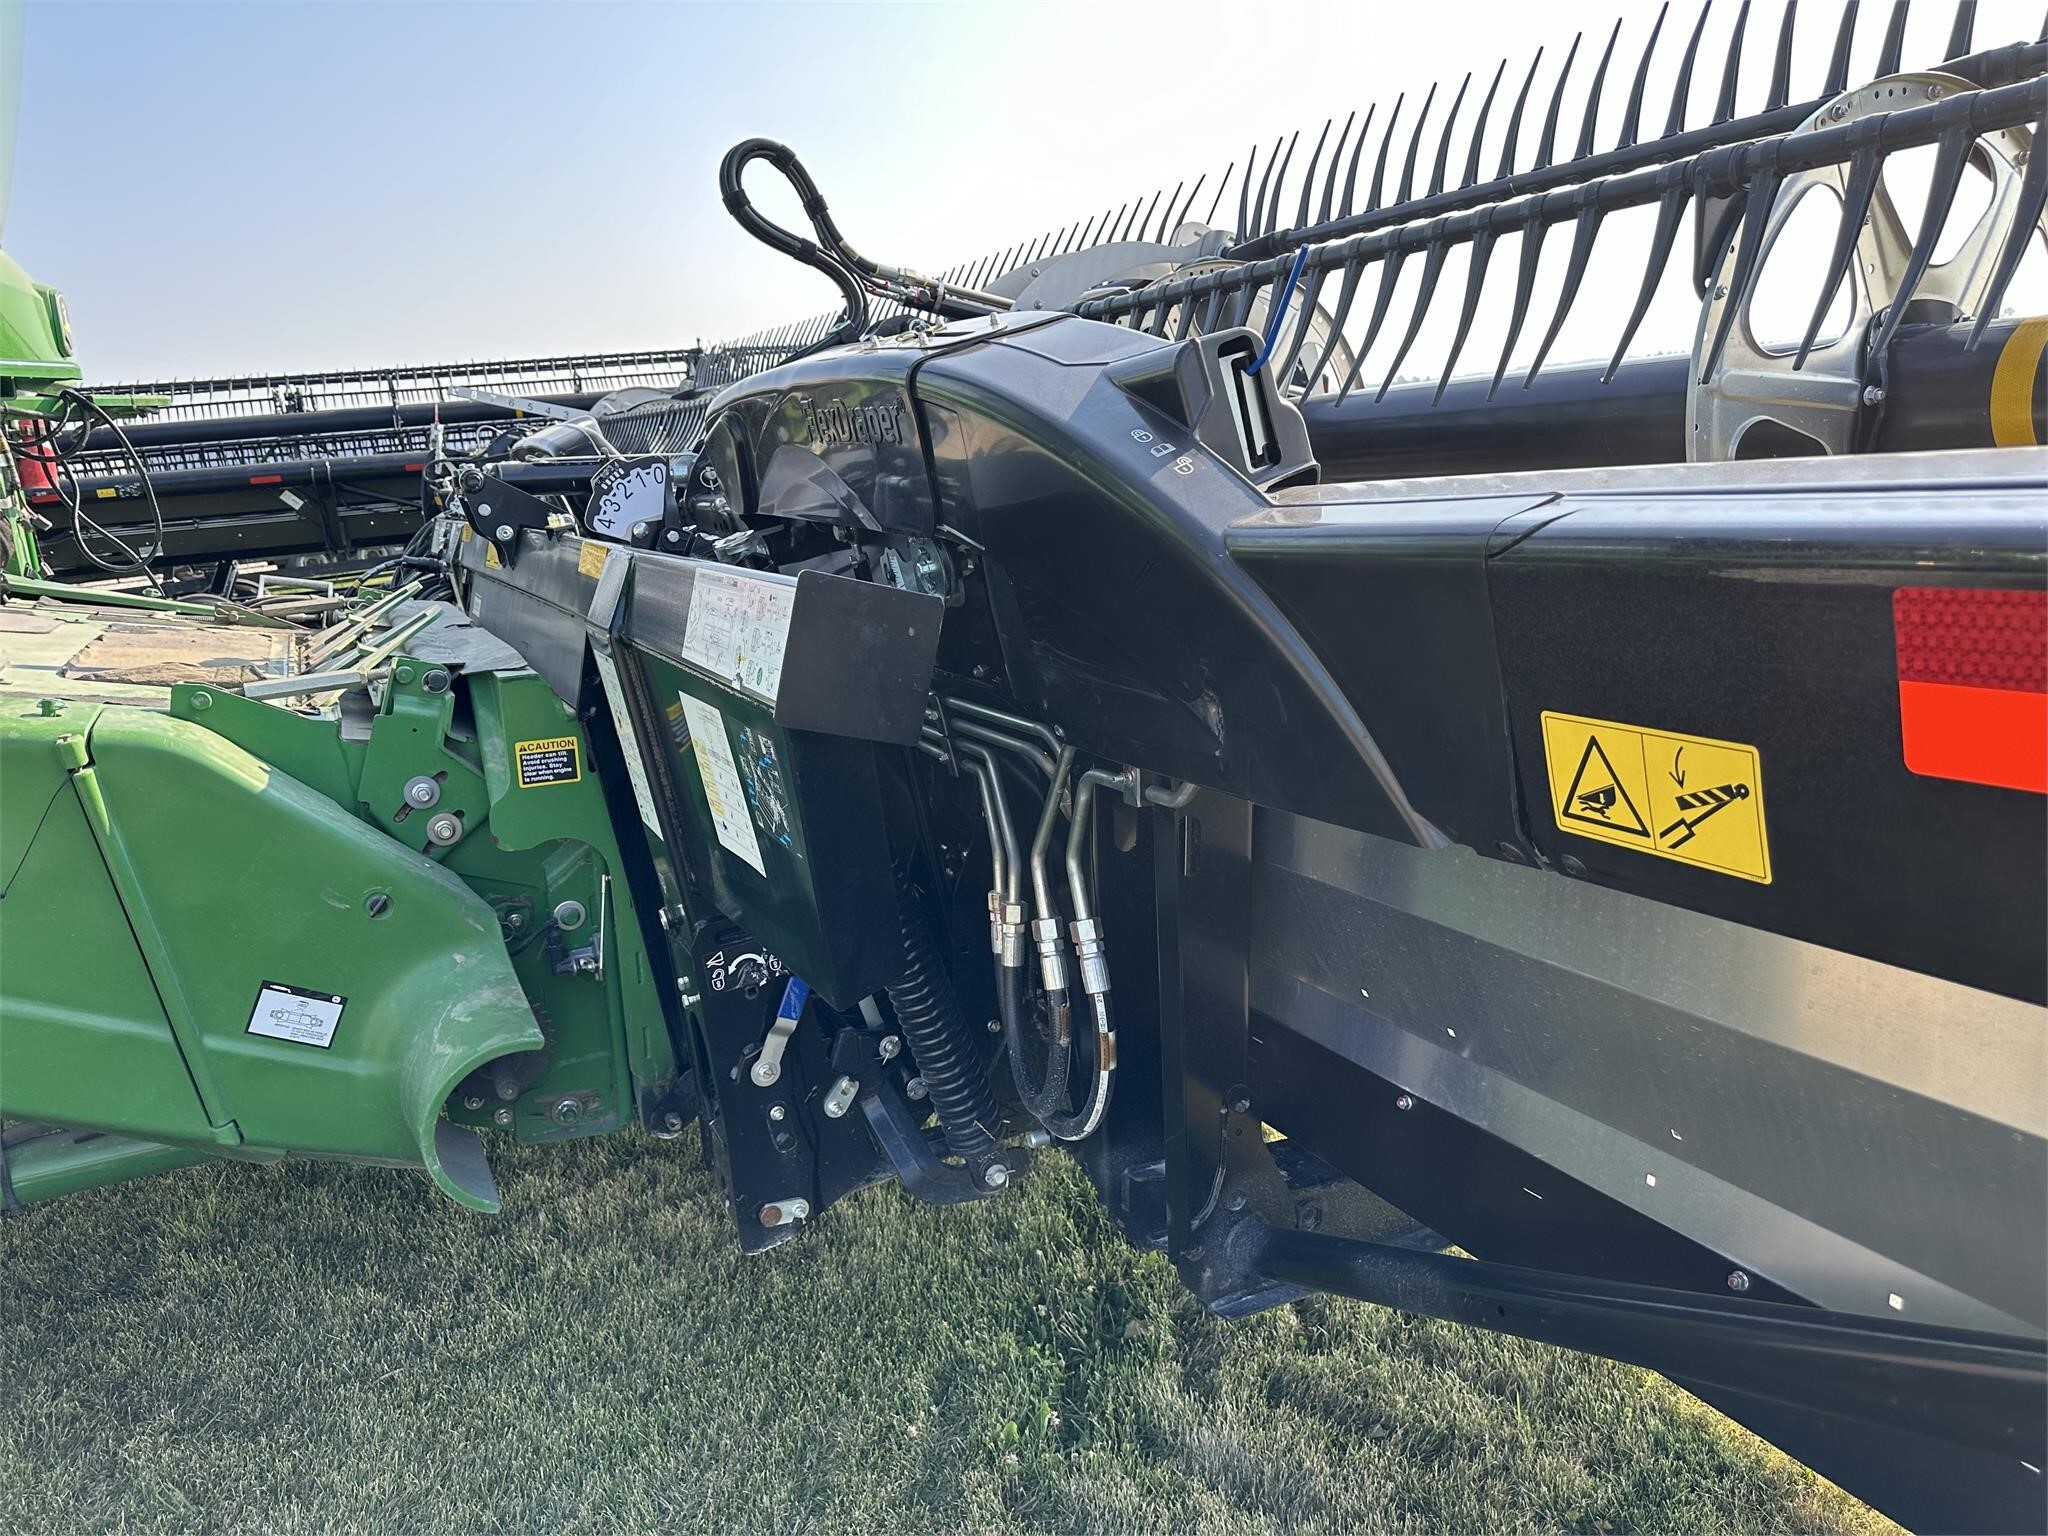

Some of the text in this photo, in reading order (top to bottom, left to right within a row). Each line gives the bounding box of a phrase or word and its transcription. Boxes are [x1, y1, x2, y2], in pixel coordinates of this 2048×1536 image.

[528, 402, 534, 411] 5
[800, 398, 903, 453] FlexDraper
[636, 472, 646, 488] 1
[654, 466, 664, 484] 0
[616, 482, 634, 500] 2
[604, 499, 621, 512] 3
[597, 518, 616, 529] 4
[528, 739, 574, 751] CAUTION
